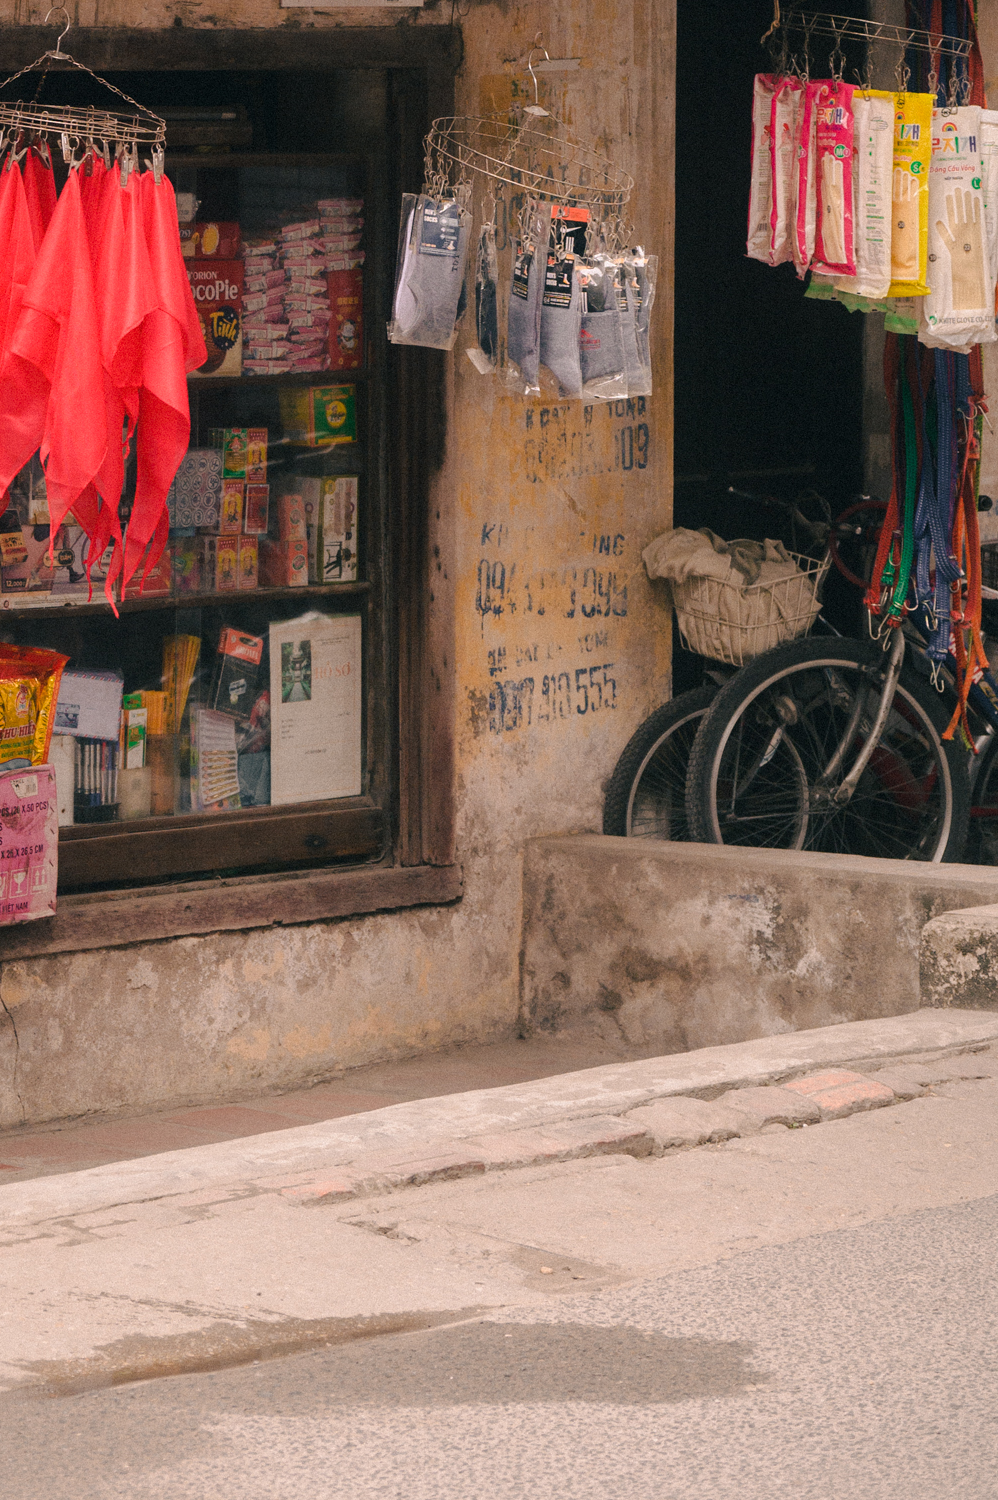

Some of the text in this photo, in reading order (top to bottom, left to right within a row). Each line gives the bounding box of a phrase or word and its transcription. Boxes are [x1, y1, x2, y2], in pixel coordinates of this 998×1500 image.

[191, 279, 238, 301] coPie
[1, 851, 5, 859] X
[16, 849, 19, 857] X
[35, 844, 43, 853] CM
[16, 902, 29, 910] NAM
